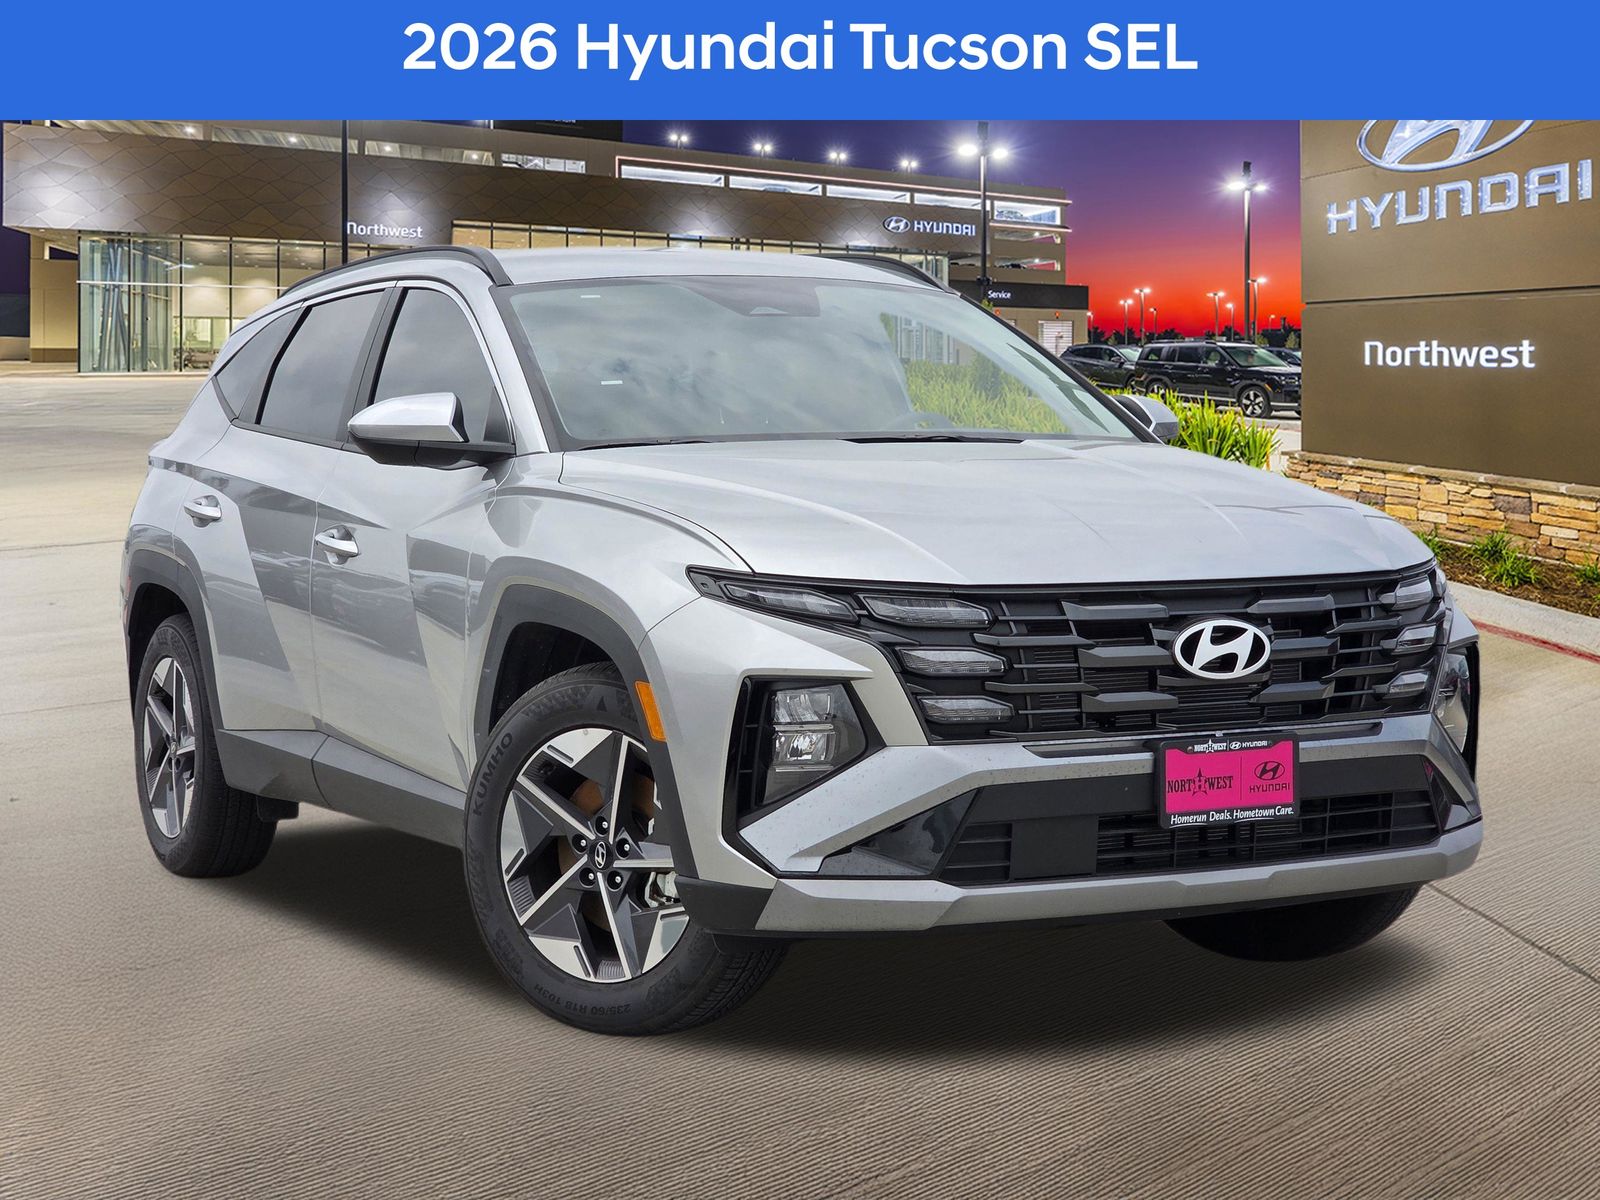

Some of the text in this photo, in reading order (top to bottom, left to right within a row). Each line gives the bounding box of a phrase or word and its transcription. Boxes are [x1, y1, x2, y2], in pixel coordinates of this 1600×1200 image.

[1327, 159, 1593, 234] HYUNDAI
[347, 221, 423, 238] Northwest
[913, 221, 976, 236] HYUNDAI
[987, 289, 1012, 300] Service
[1364, 339, 1536, 368] Northwest
[1242, 740, 1268, 748] HYUNDAI
[473, 732, 513, 816] KUMHO
[1249, 782, 1291, 793] HYUNDAI
[1170, 805, 1294, 825] Homerun Deals. Hometown Care.
